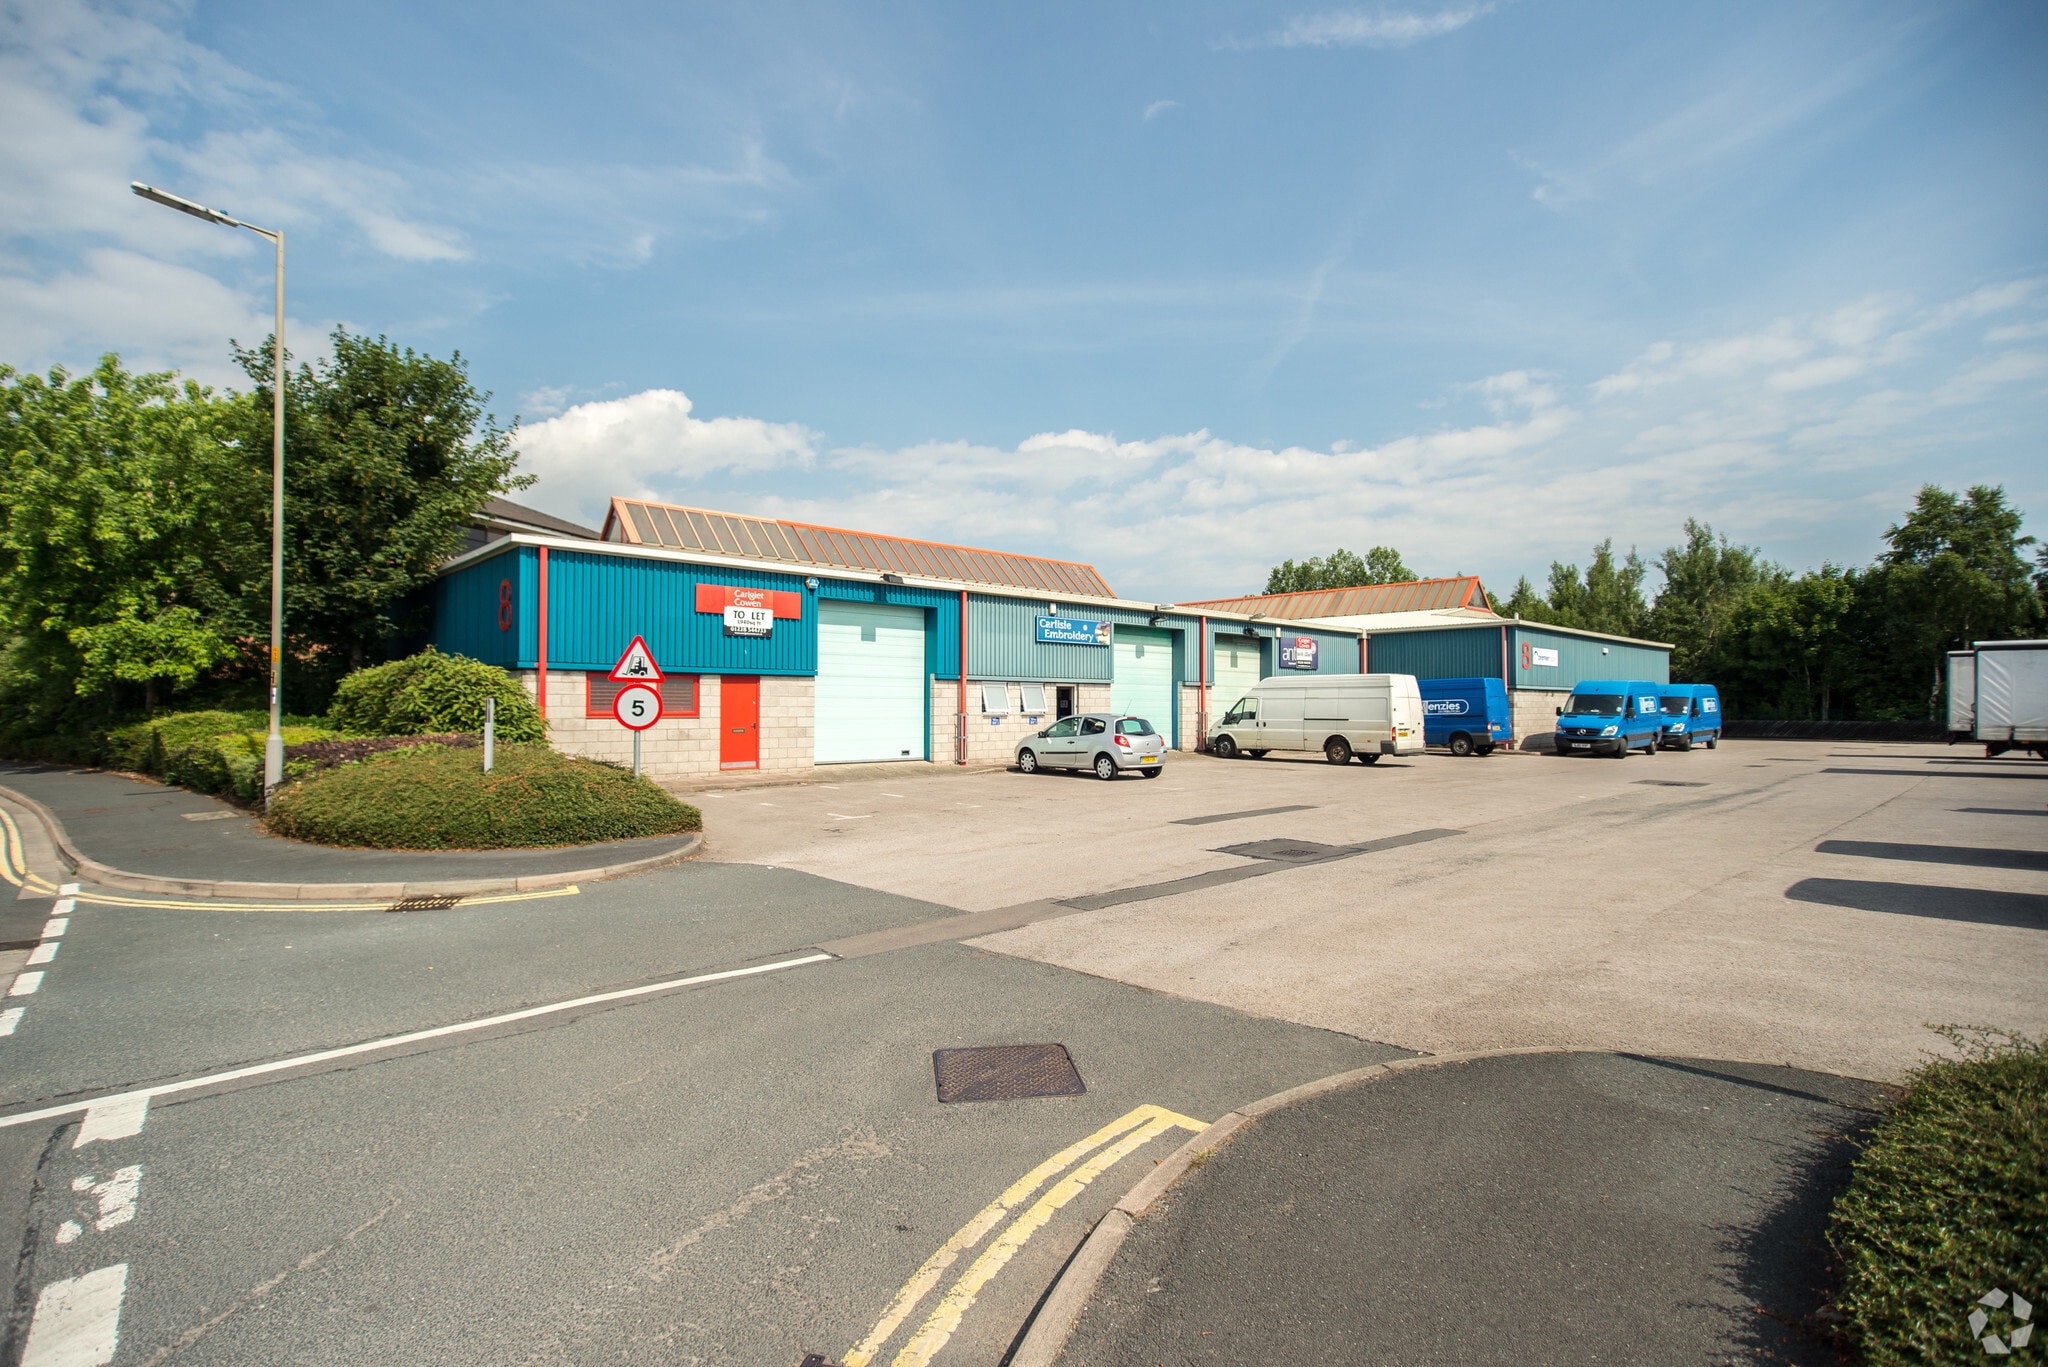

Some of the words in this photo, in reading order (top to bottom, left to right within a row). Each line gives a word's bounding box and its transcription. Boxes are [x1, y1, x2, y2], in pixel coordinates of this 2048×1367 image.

[734, 589, 764, 600] Carigiet
[499, 579, 512, 631] 8
[734, 598, 762, 607] Cowen
[733, 610, 745, 619] TO
[751, 612, 765, 620] LET
[1039, 619, 1072, 630] Carlisle
[1044, 629, 1094, 643] Embroidery
[1522, 641, 1531, 670] 8
[631, 700, 645, 717] 5
